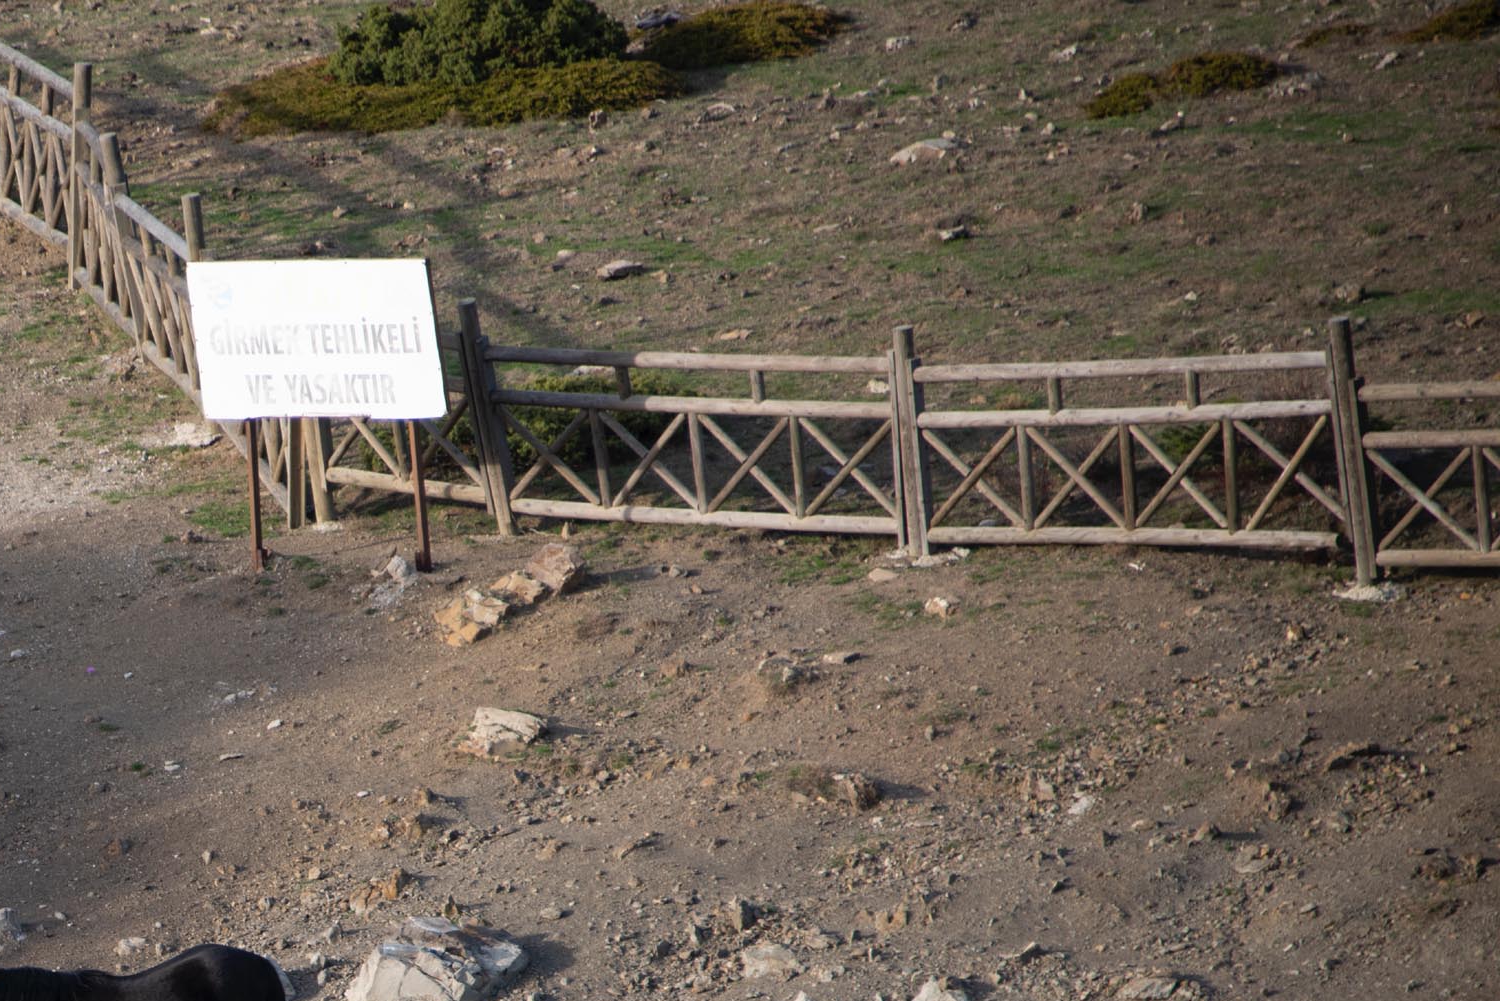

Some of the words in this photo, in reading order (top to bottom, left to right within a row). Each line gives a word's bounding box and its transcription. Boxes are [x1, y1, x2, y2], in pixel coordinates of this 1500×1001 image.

[307, 316, 423, 355] TEHLİKELİ
[245, 373, 276, 405] VE
[284, 373, 396, 405] YASAKTIR
